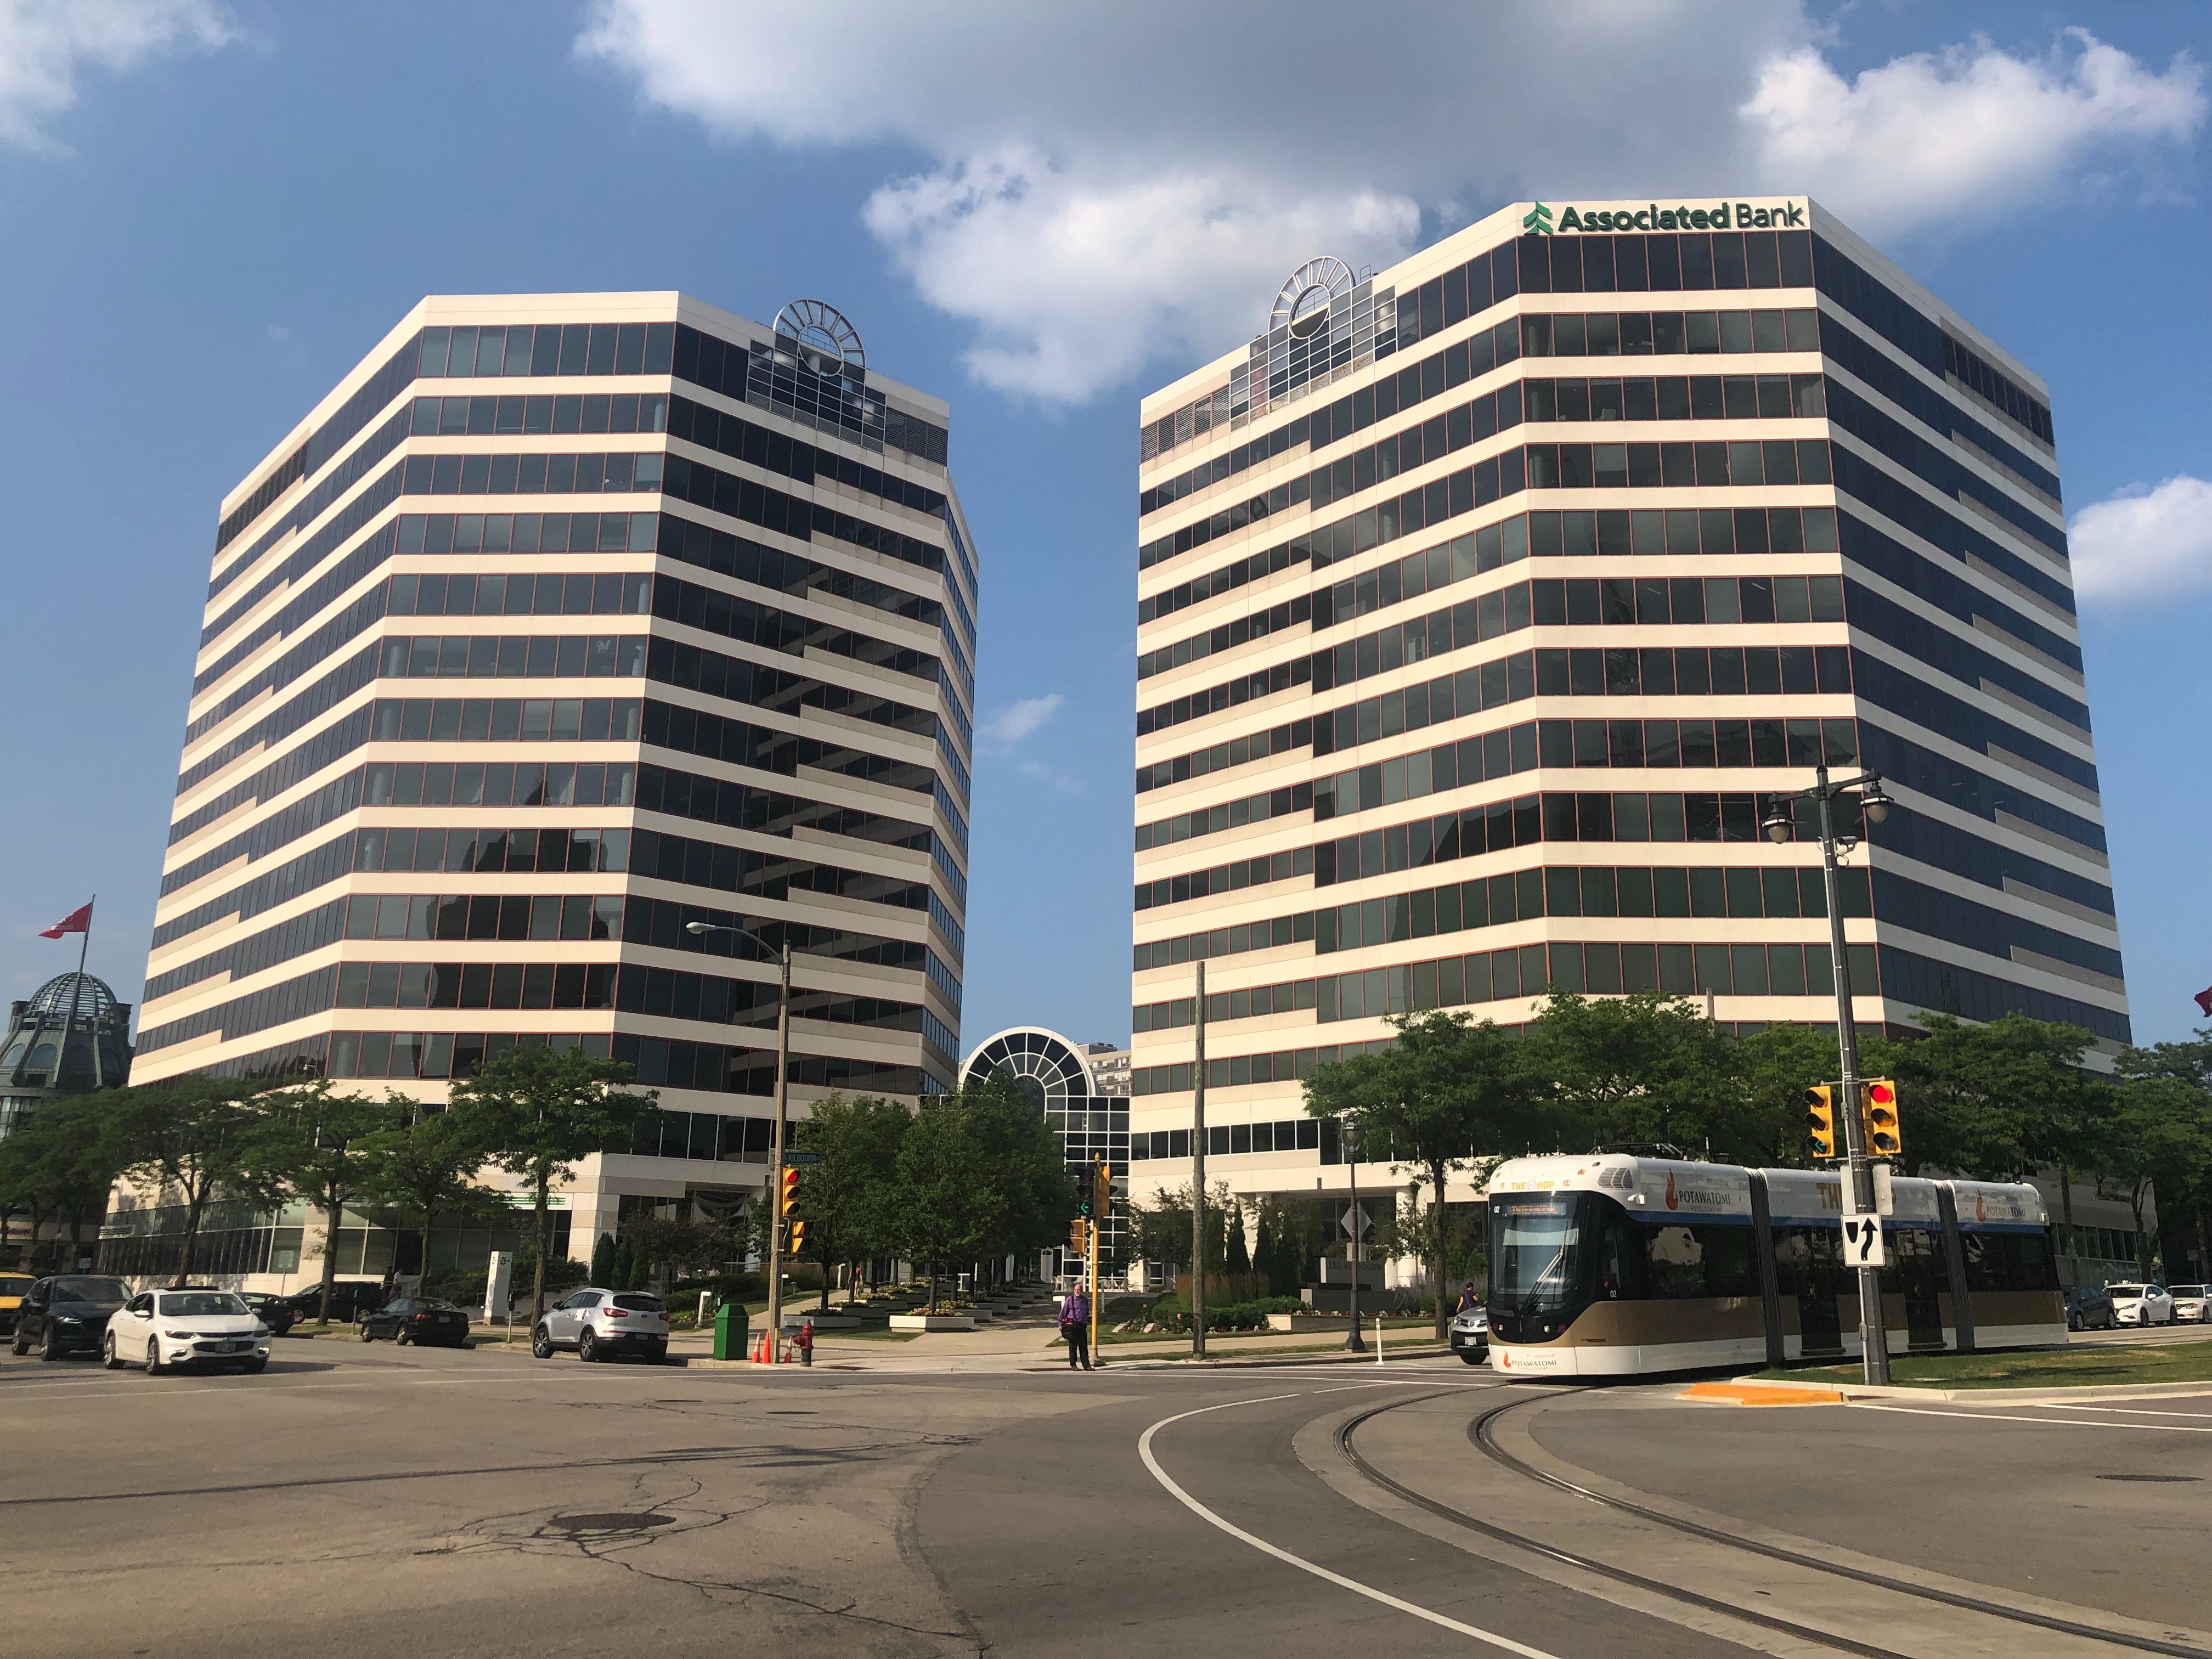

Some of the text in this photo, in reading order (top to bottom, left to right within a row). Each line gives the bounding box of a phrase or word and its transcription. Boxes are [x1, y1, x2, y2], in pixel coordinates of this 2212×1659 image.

[1558, 200, 1805, 232] Associated Bank
[788, 1154, 816, 1162] KILBOURN
[1511, 1181, 1555, 1190] THE HOP
[1679, 1190, 1731, 1205] POTAWATOMI
[1493, 1205, 1500, 1214] 02
[1985, 1206, 2027, 1217] POTAWATOMI
